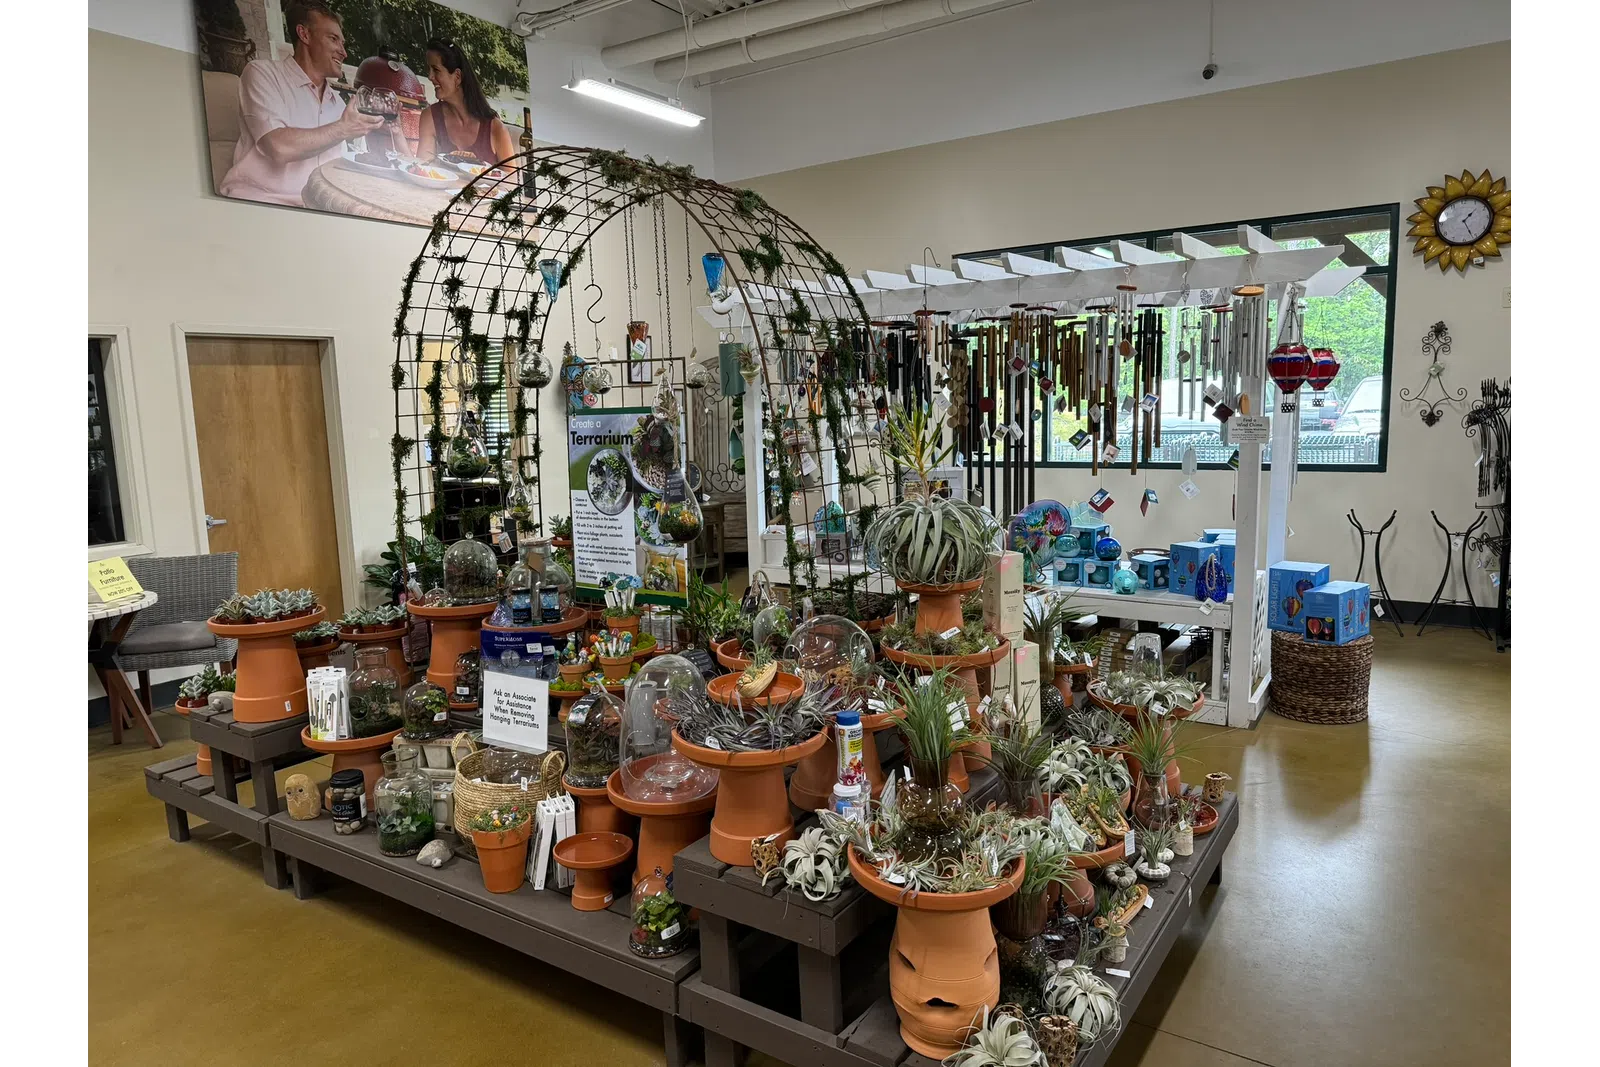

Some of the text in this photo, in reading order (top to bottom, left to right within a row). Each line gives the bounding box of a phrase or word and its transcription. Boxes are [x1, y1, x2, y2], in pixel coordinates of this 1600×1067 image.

[570, 418, 594, 428] Create
[570, 430, 633, 446] Terrarium
[100, 575, 124, 585] Furniture
[512, 692, 536, 702] Associate
[506, 700, 531, 710] Assistance
[494, 705, 535, 721] When Removing
[490, 712, 539, 729] Hanging Terrariums
